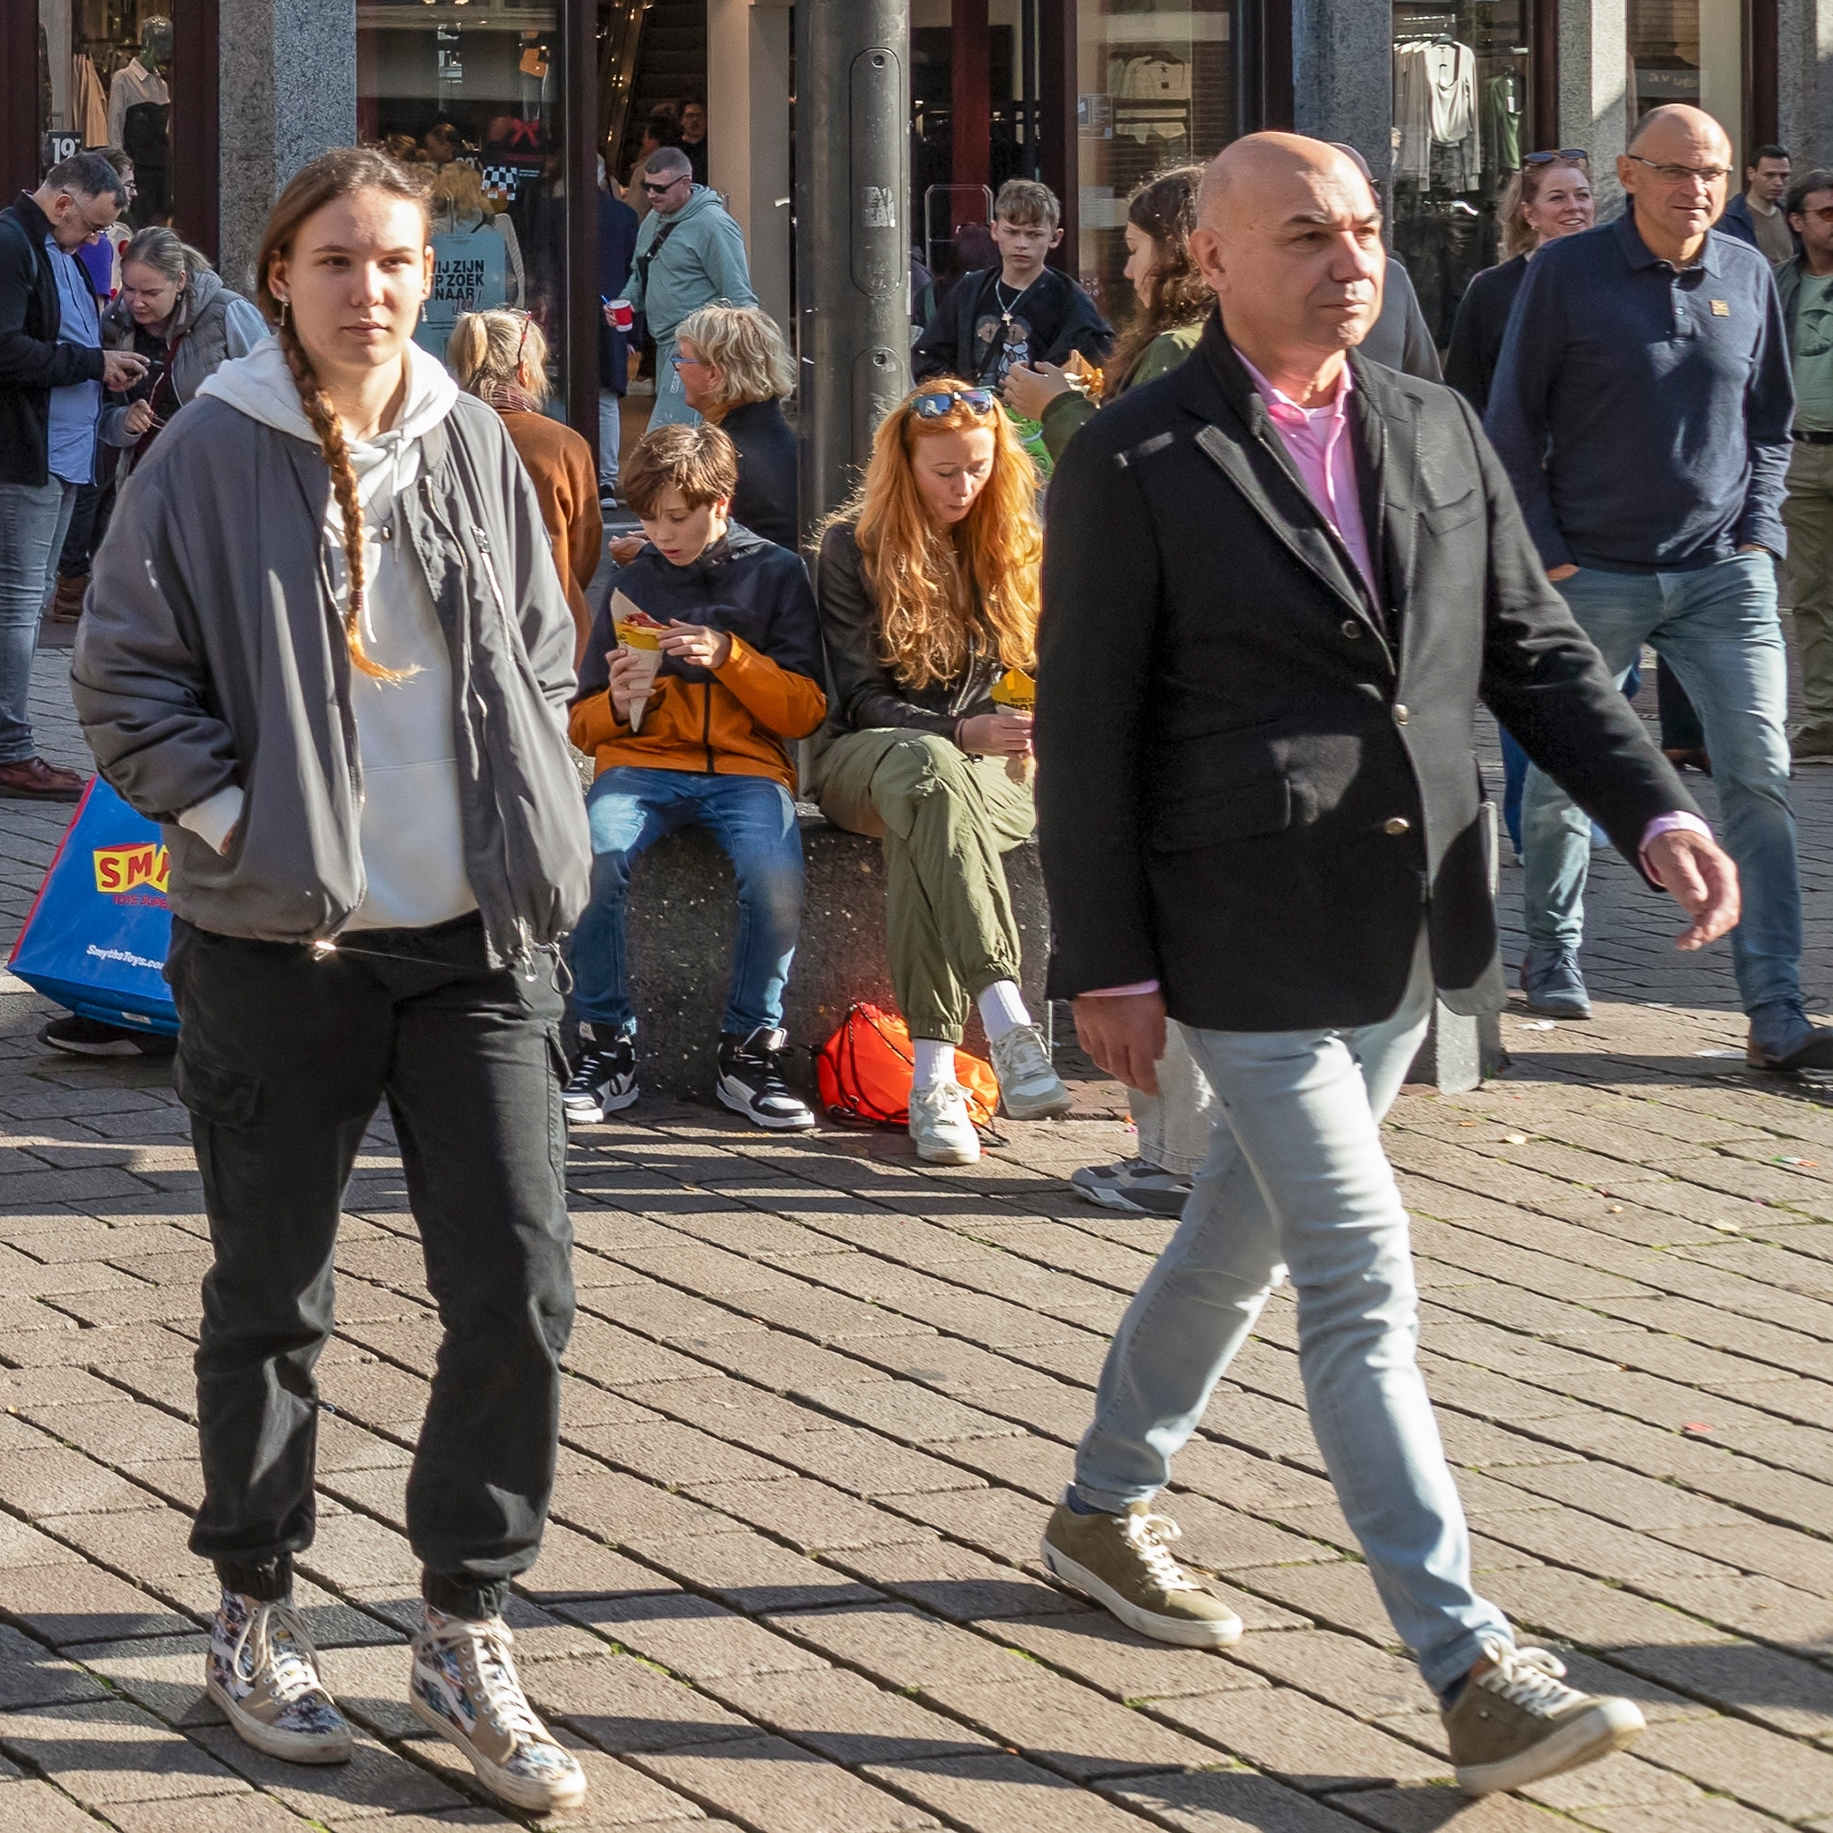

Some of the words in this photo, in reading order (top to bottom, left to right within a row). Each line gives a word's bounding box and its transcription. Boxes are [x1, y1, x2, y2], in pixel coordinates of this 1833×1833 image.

[453, 260, 485, 274] ZIJN
[446, 273, 485, 287] ZOEK
[434, 287, 475, 301] NAAR
